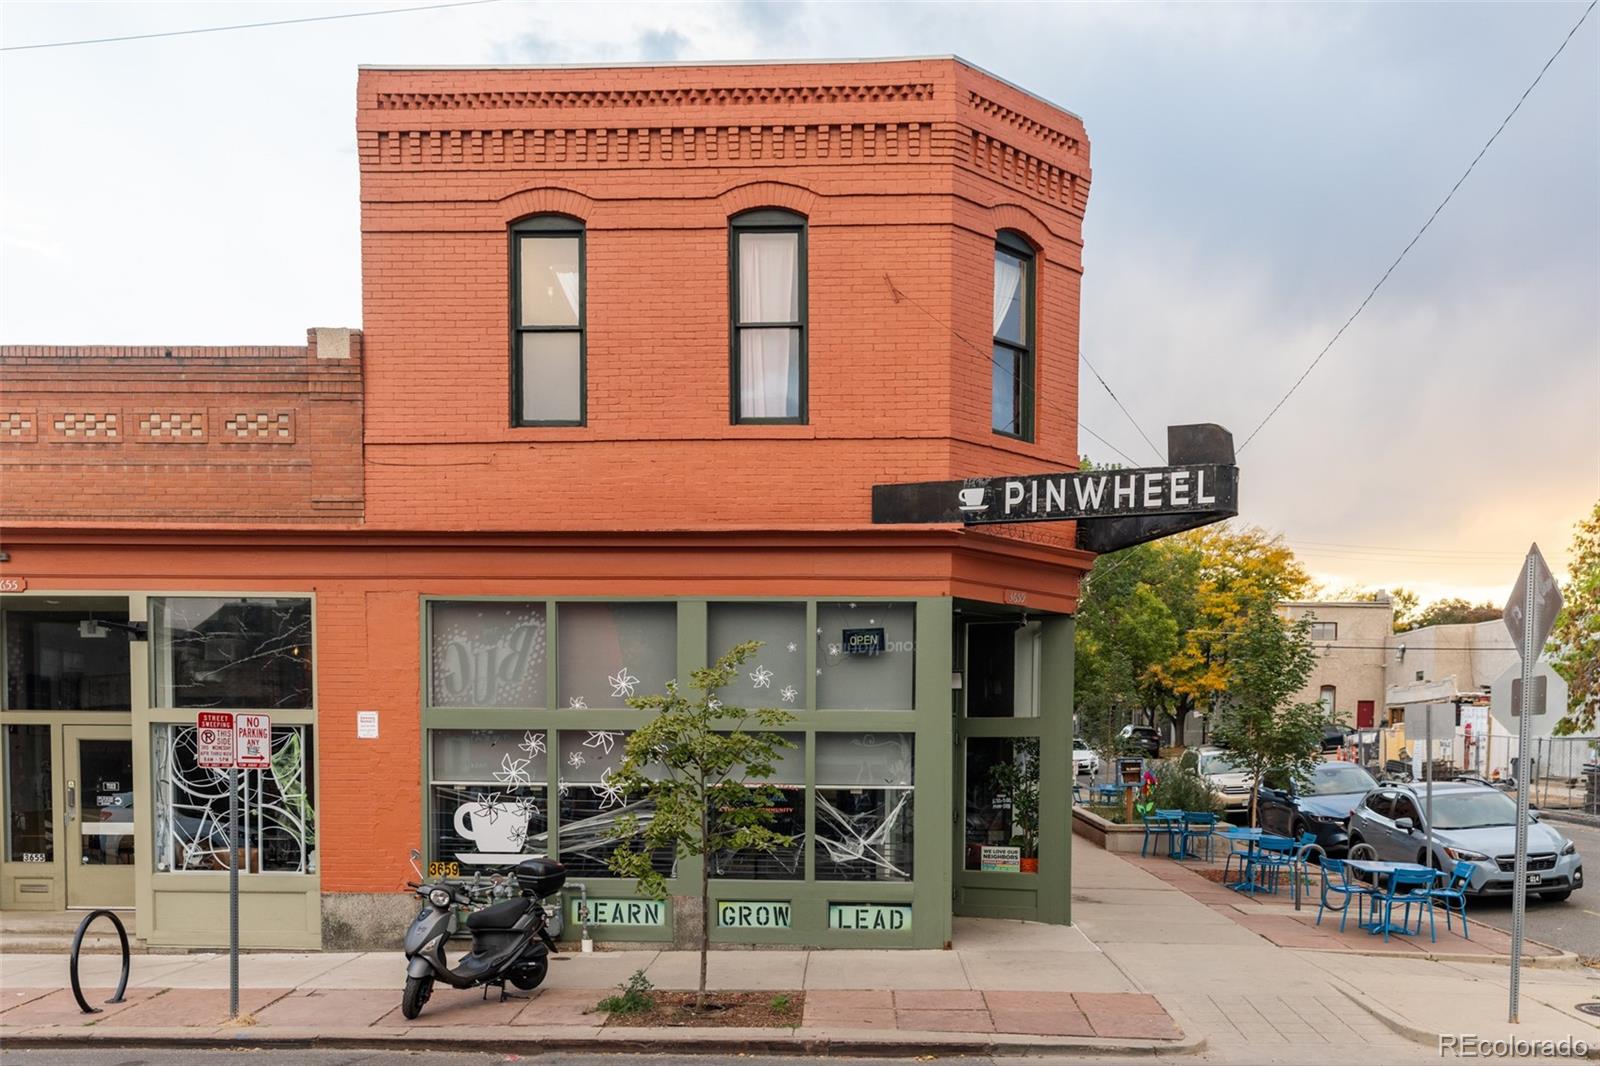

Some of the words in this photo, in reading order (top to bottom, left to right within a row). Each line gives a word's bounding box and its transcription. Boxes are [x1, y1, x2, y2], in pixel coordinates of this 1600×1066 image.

[1004, 469, 1216, 515] PINWHEEL
[849, 634, 878, 646] OPEN
[203, 714, 228, 722] STREET
[246, 717, 260, 727] NO
[217, 730, 232, 738] THIS
[238, 728, 267, 739] PARKING
[217, 737, 232, 746] SIDE
[24, 853, 45, 862] 3655
[430, 863, 459, 876] 3659
[577, 902, 659, 924] LEARN
[722, 905, 790, 928] GROW
[837, 907, 904, 930] LEAD
